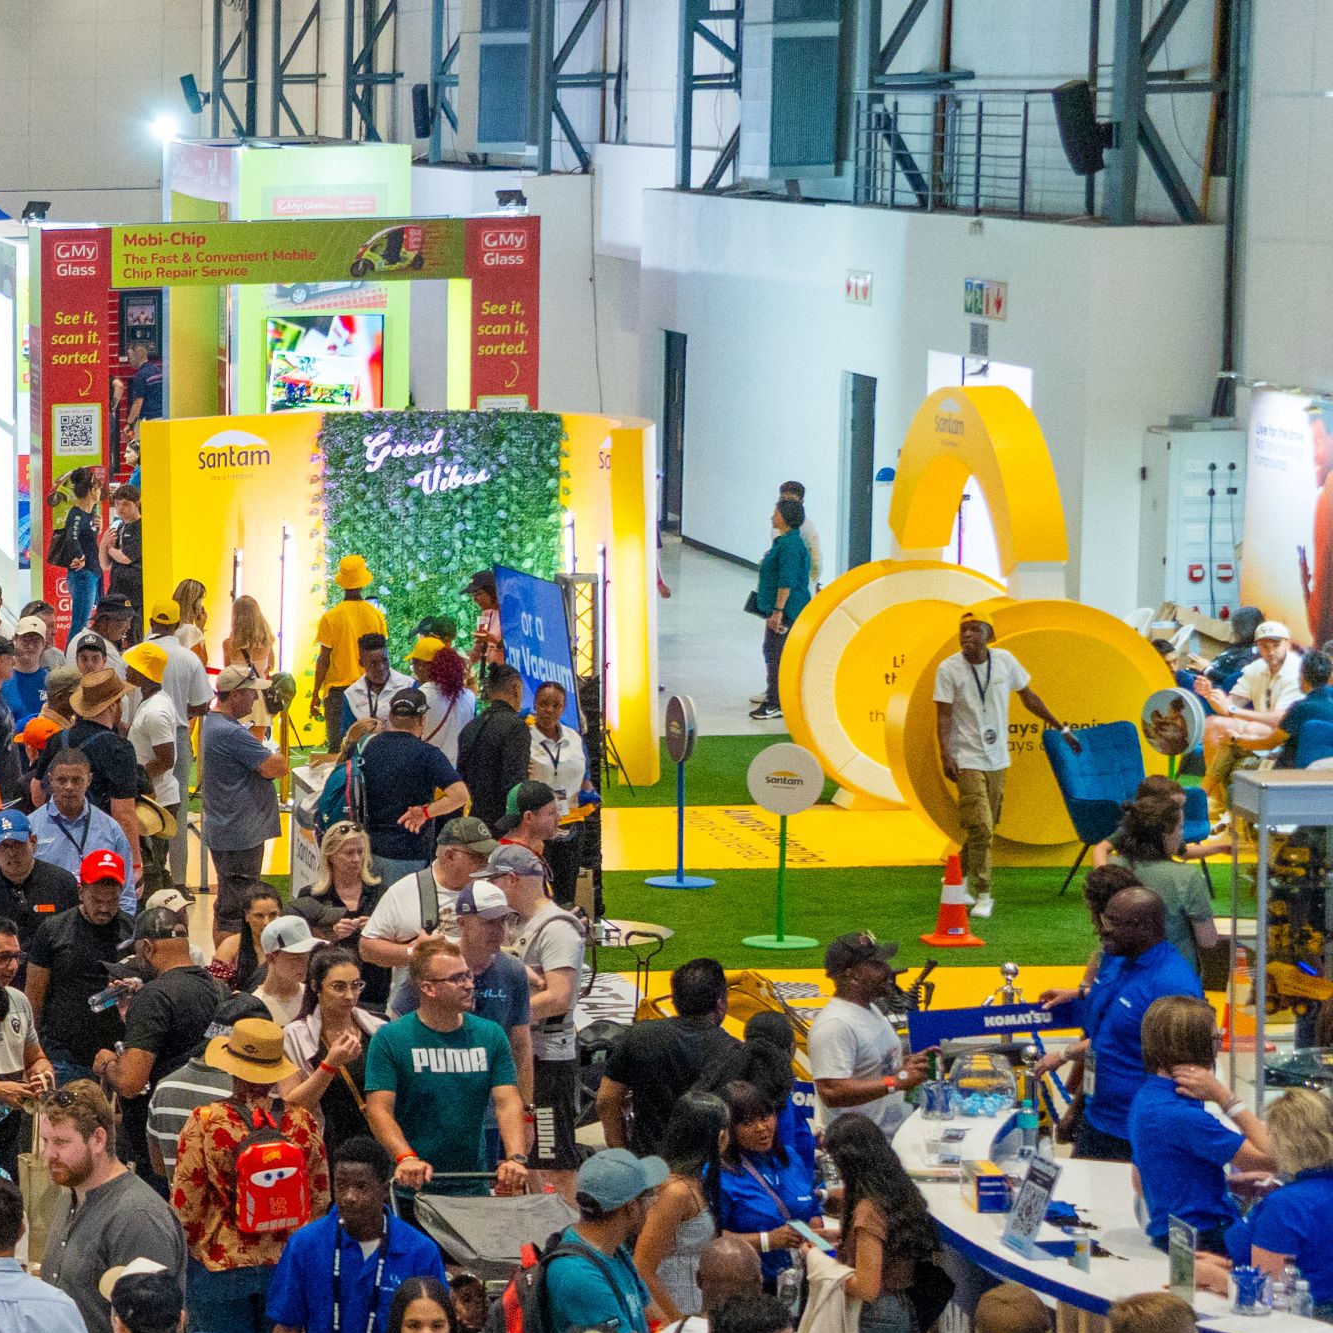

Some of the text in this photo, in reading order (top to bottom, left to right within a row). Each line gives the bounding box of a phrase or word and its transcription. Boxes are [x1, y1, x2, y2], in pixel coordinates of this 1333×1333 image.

[123, 231, 206, 248] Mobi-Chip
[123, 248, 317, 265] The Fast & Convenient Mobile
[483, 252, 524, 265] Glass
[56, 263, 96, 277] Glass
[123, 265, 248, 280] Chip Repair Service
[481, 301, 525, 316] See it,
[54, 311, 98, 326] See it,
[477, 320, 529, 336] scan it,
[51, 330, 102, 346] scan it,
[477, 341, 528, 356] sorted.
[51, 350, 101, 365] sorted.
[198, 444, 271, 470] santam
[363, 429, 443, 472] Good
[414, 467, 492, 496] Vibes
[764, 775, 804, 786] santam
[984, 1012, 1053, 1027] KOMATSU
[411, 1047, 488, 1073] PUMA
[536, 1107, 556, 1159] PUMA
